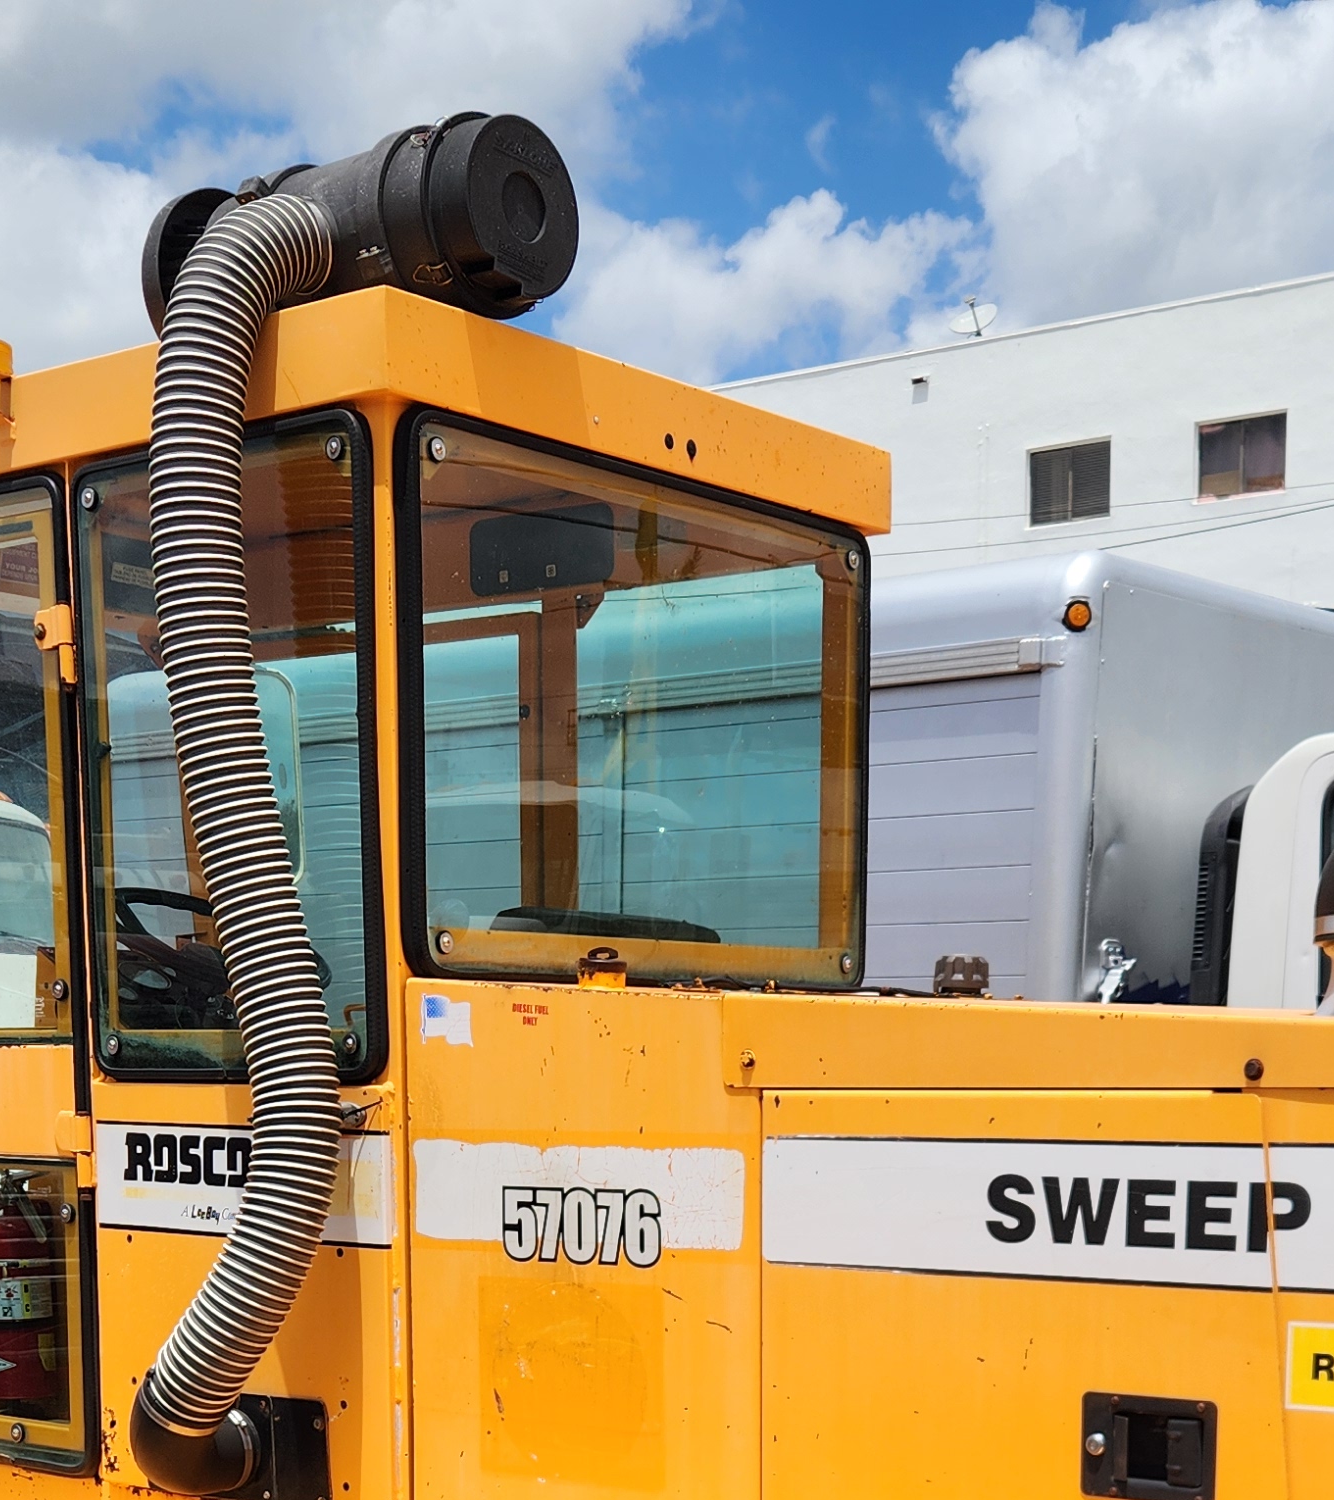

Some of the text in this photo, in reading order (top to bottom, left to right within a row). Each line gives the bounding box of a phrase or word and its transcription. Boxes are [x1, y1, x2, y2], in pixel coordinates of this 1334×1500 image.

[512, 1003, 549, 1015] DIESEL FUEL
[523, 1016, 538, 1026] ONLY
[124, 1132, 252, 1188] ROSCO
[181, 1205, 189, 1217] A
[502, 1185, 662, 1269] 57076
[985, 1173, 1312, 1253] SWEEP
